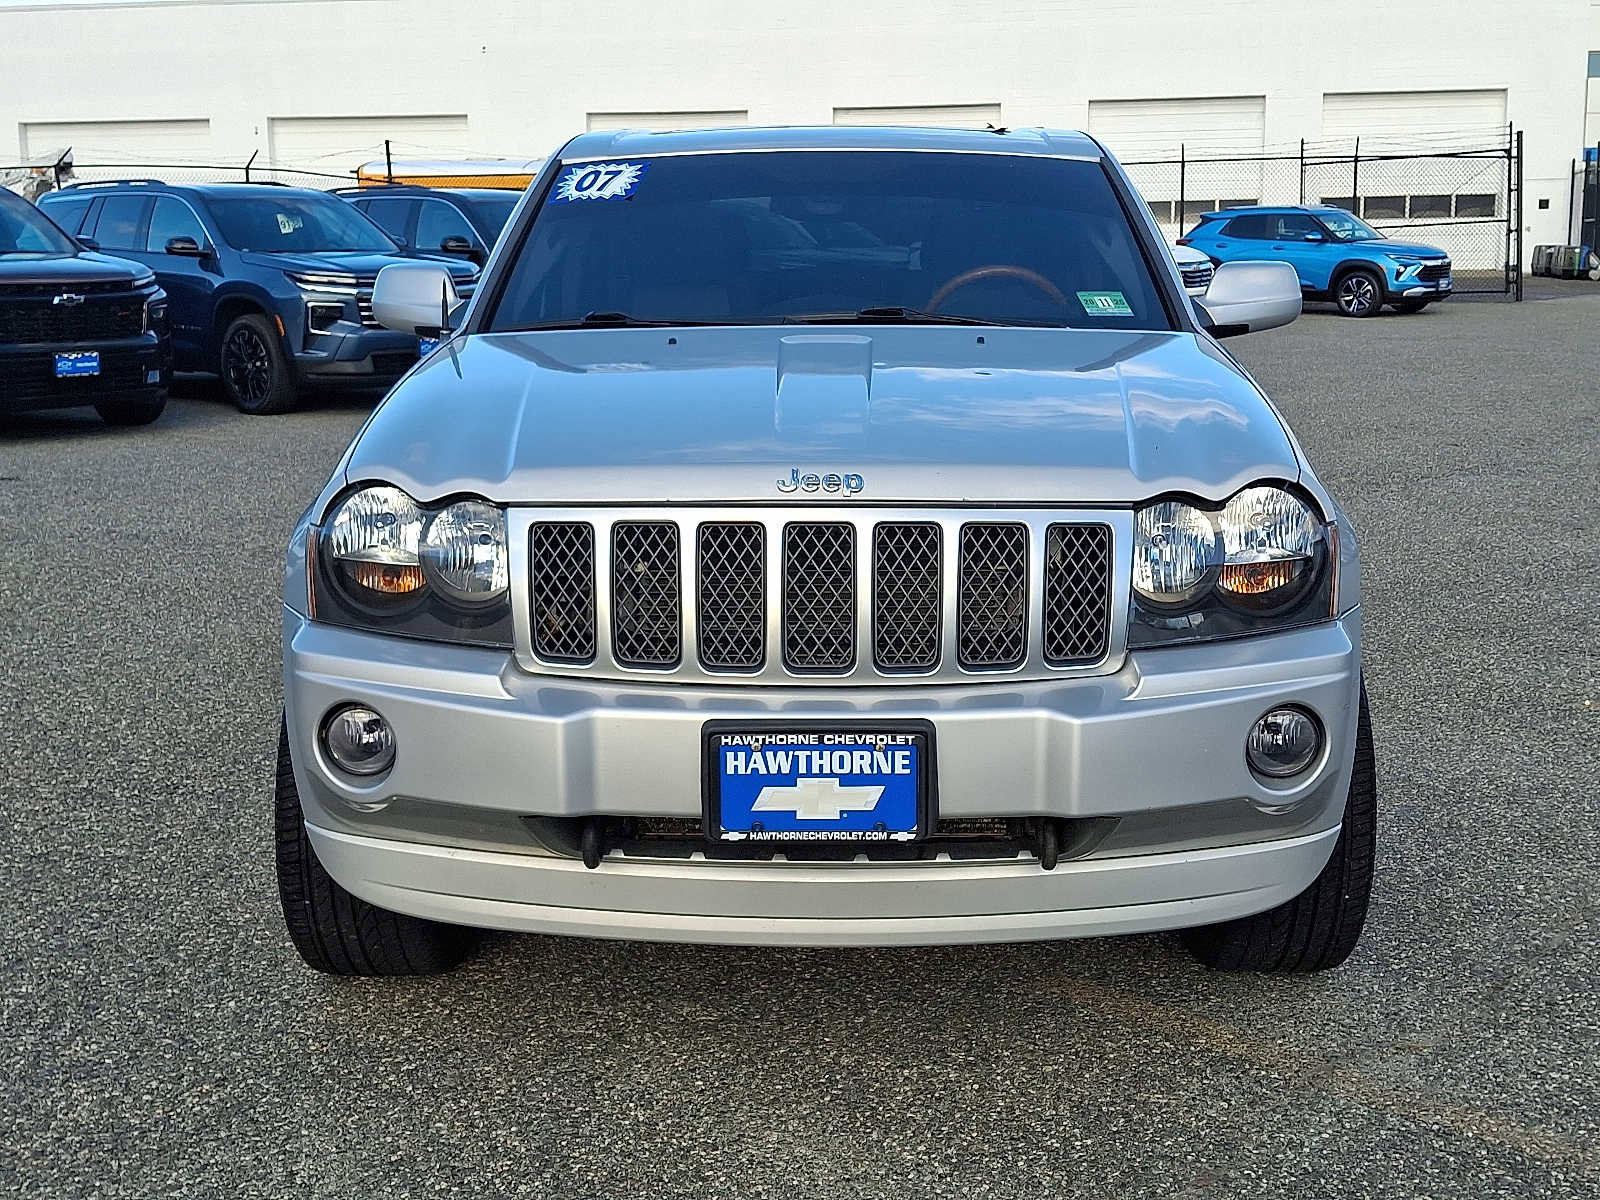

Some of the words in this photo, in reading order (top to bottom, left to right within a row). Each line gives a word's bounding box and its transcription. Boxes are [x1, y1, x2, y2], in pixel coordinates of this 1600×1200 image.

[574, 169, 624, 193] 07
[1098, 298, 1111, 307] 11
[776, 467, 865, 497] Jeep
[721, 734, 819, 746] HAWTHORNE
[824, 734, 916, 746] CHEVROLET
[726, 750, 911, 775] HAWTHORNE
[749, 831, 888, 841] HAWTHORNECHEVROLET.COM
